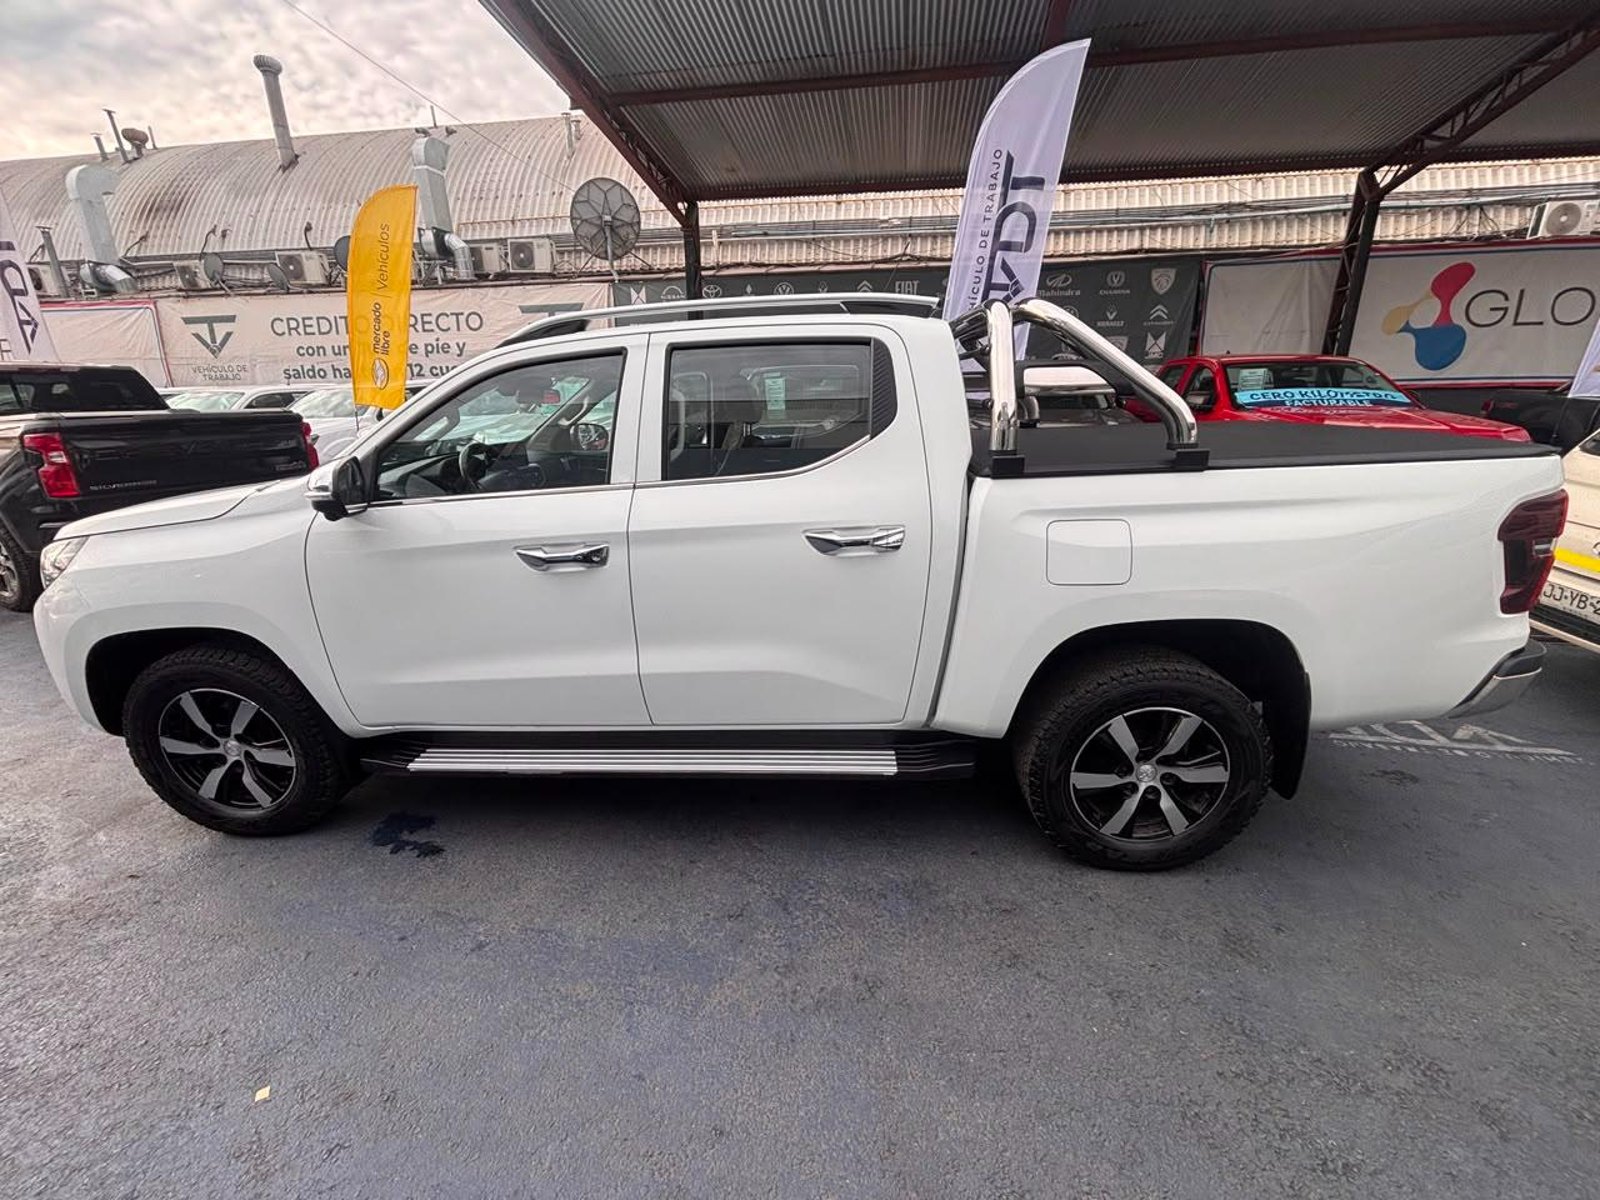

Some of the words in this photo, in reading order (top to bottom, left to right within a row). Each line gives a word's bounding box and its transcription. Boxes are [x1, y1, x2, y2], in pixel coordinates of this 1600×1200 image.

[969, 255, 985, 310] HÍCULO
[978, 229, 990, 248] DE
[984, 149, 1003, 223] TRABAJO
[377, 223, 390, 291] Vehículos
[372, 302, 382, 354] mercado
[296, 345, 326, 357] con
[408, 342, 419, 354] e
[424, 337, 451, 358] pie
[456, 341, 466, 357] y
[380, 330, 390, 356] libre
[202, 373, 241, 381] TRABAJO
[236, 364, 248, 373] DE
[283, 364, 327, 380] saldo
[1249, 390, 1295, 401] CERO
[1284, 398, 1374, 407] FACTURABLE
